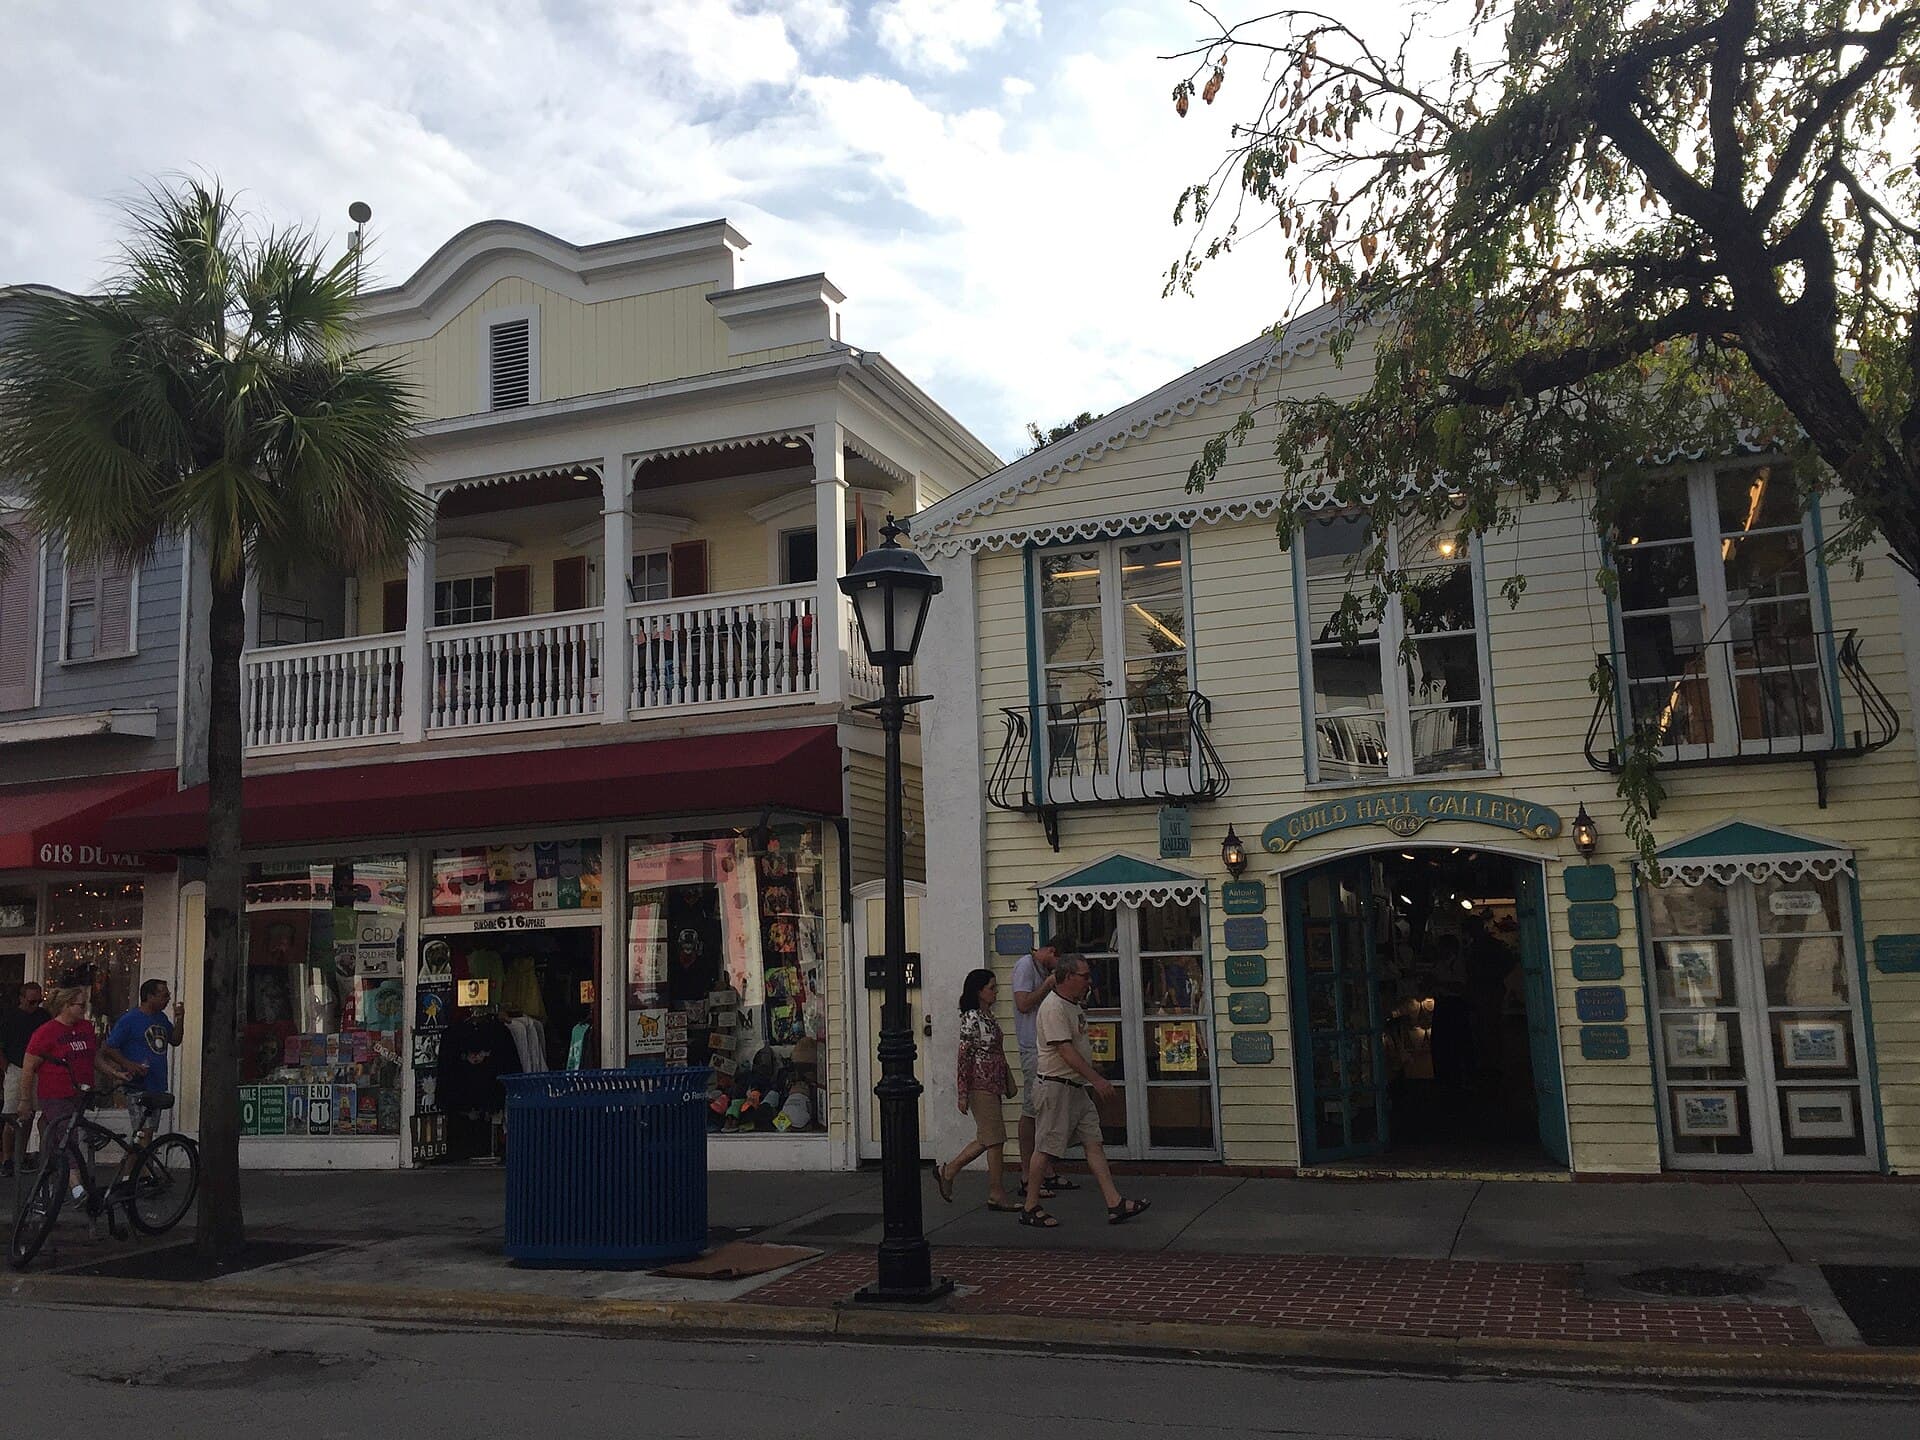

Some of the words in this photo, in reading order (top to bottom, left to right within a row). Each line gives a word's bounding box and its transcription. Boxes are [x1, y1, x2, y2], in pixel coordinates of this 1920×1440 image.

[1287, 804, 1347, 837] GUILD
[1356, 795, 1419, 819] HALL
[1427, 794, 1535, 827] GALLERY
[1394, 818, 1417, 831] 614
[40, 843, 73, 864] 618
[497, 915, 525, 929] 616
[361, 927, 394, 942] CBD
[358, 950, 377, 959] SOLD
[378, 950, 395, 958] HERE
[240, 1088, 257, 1101] MILE
[310, 1086, 330, 1098] END
[413, 1143, 448, 1158] PABLO
